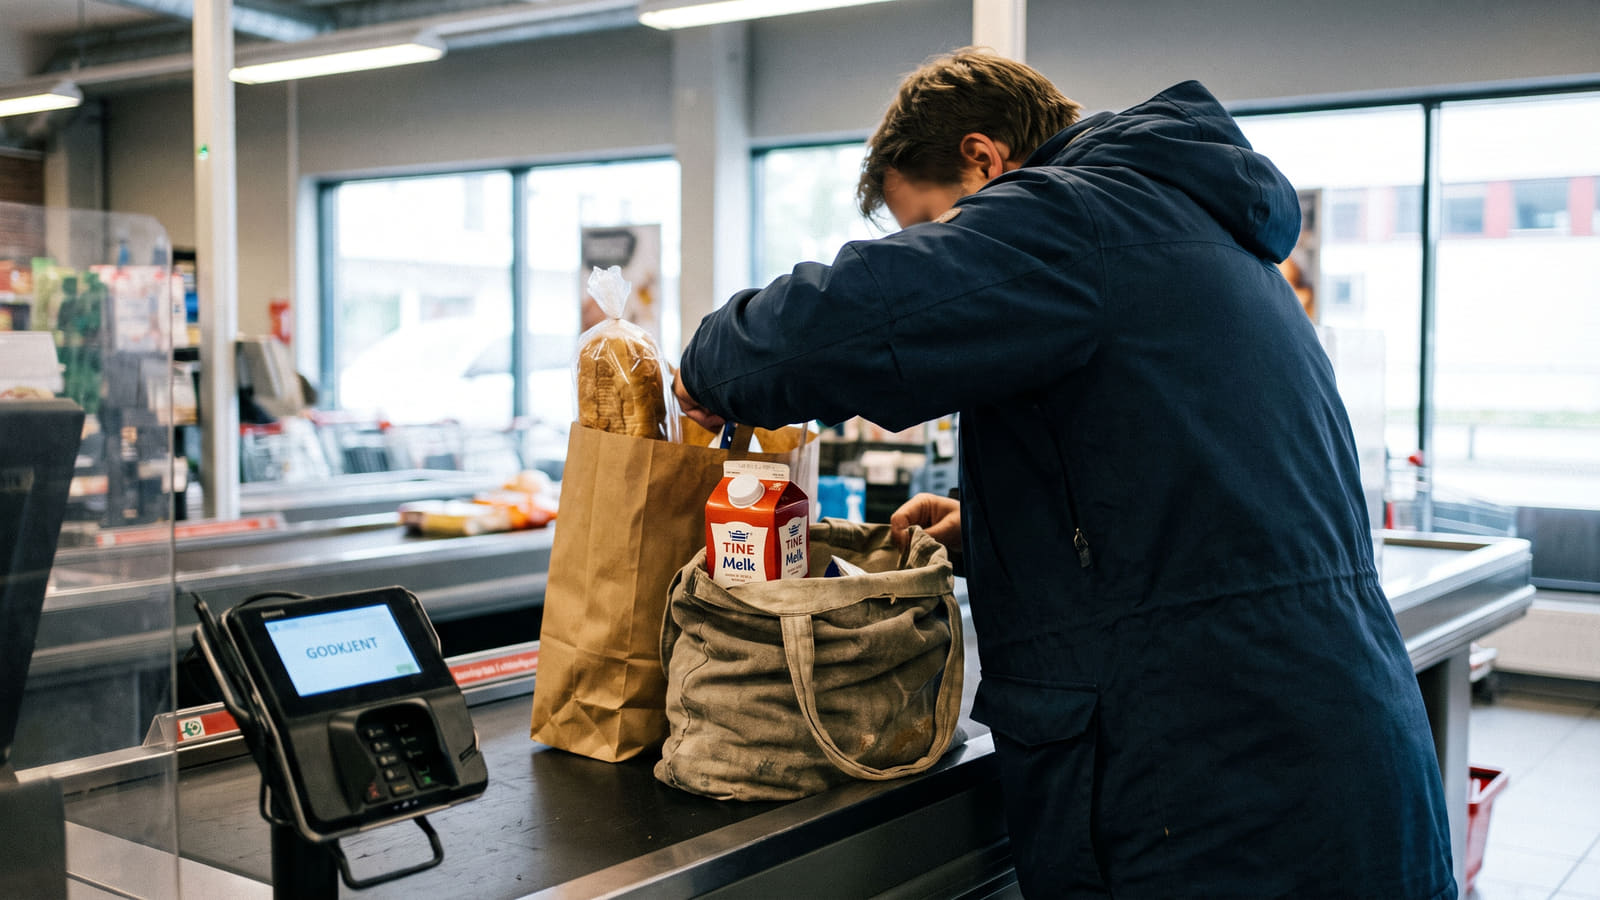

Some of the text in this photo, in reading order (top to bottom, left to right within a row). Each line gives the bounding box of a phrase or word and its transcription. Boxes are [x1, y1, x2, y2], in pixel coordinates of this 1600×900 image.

[723, 542, 755, 555] TINE
[786, 535, 803, 550] TINE
[723, 556, 756, 572] Melk
[785, 549, 803, 566] Melk
[306, 637, 378, 659] GODKJENT
